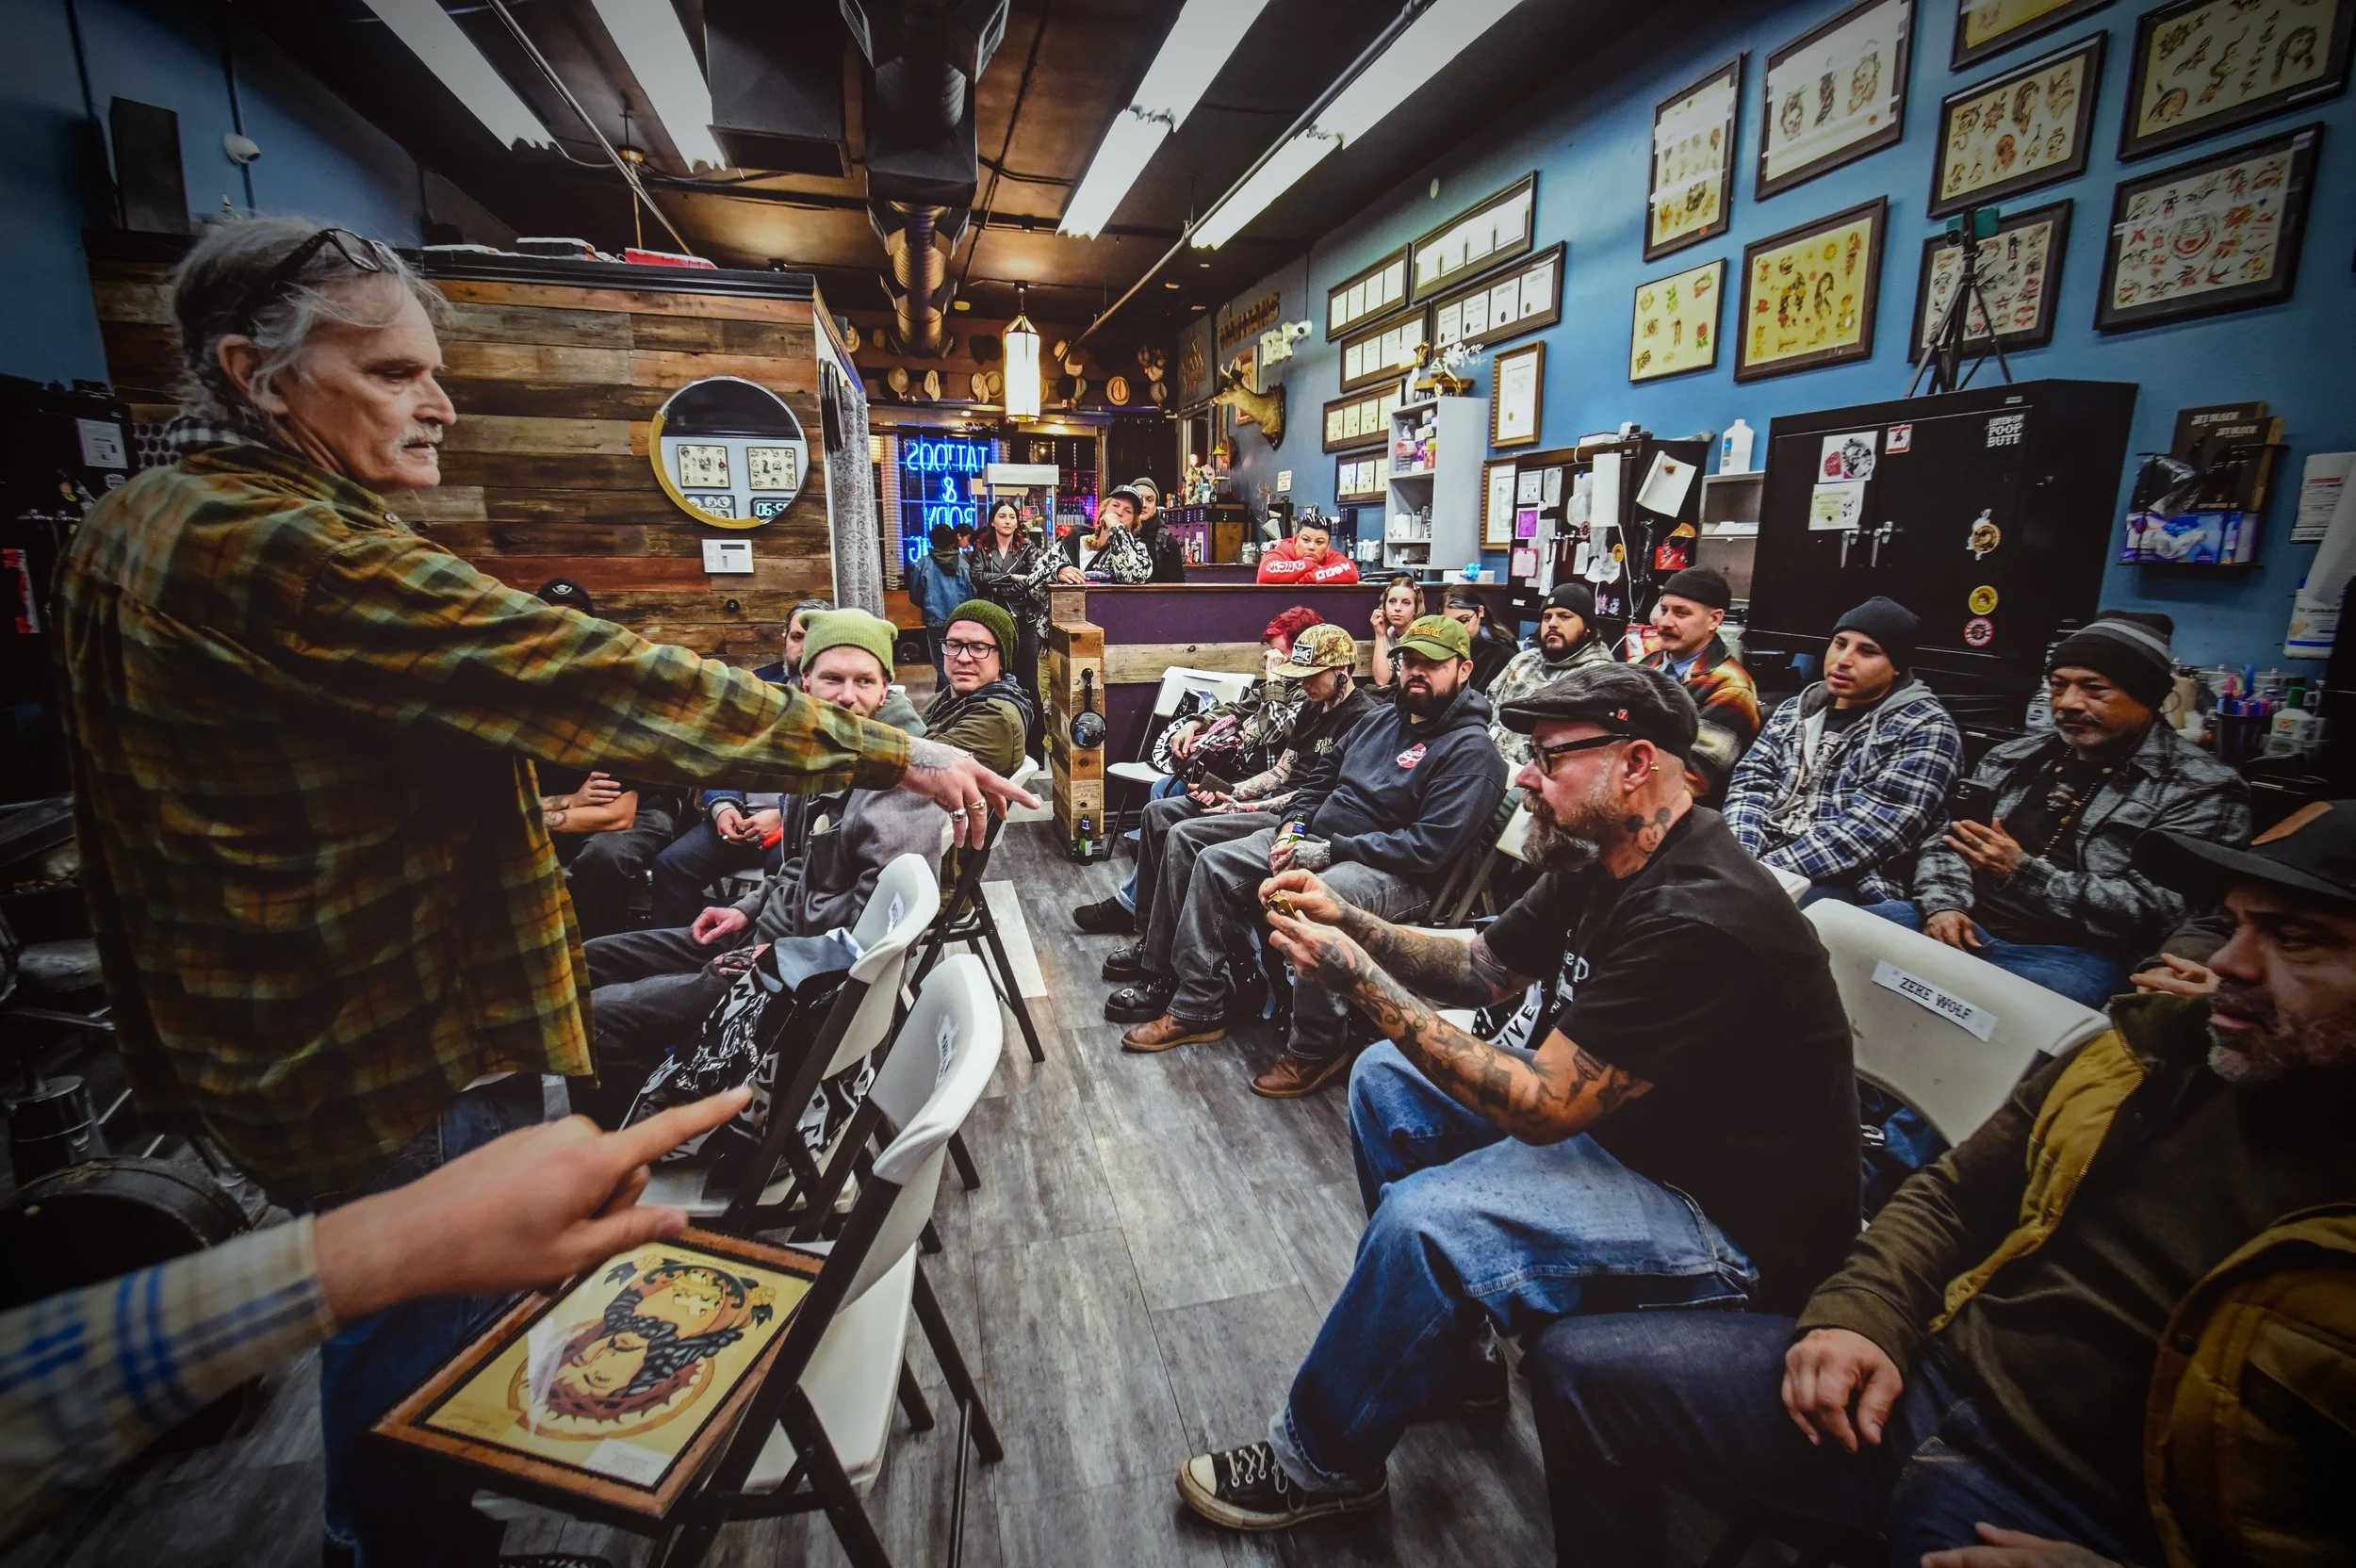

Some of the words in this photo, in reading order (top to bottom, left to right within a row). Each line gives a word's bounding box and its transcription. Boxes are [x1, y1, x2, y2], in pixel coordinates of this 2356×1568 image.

[1988, 423, 2023, 437] POOP
[1987, 433, 2022, 448] BUTT
[1899, 977, 1934, 1001] ZEKE
[1936, 993, 1972, 1020] WOLF
